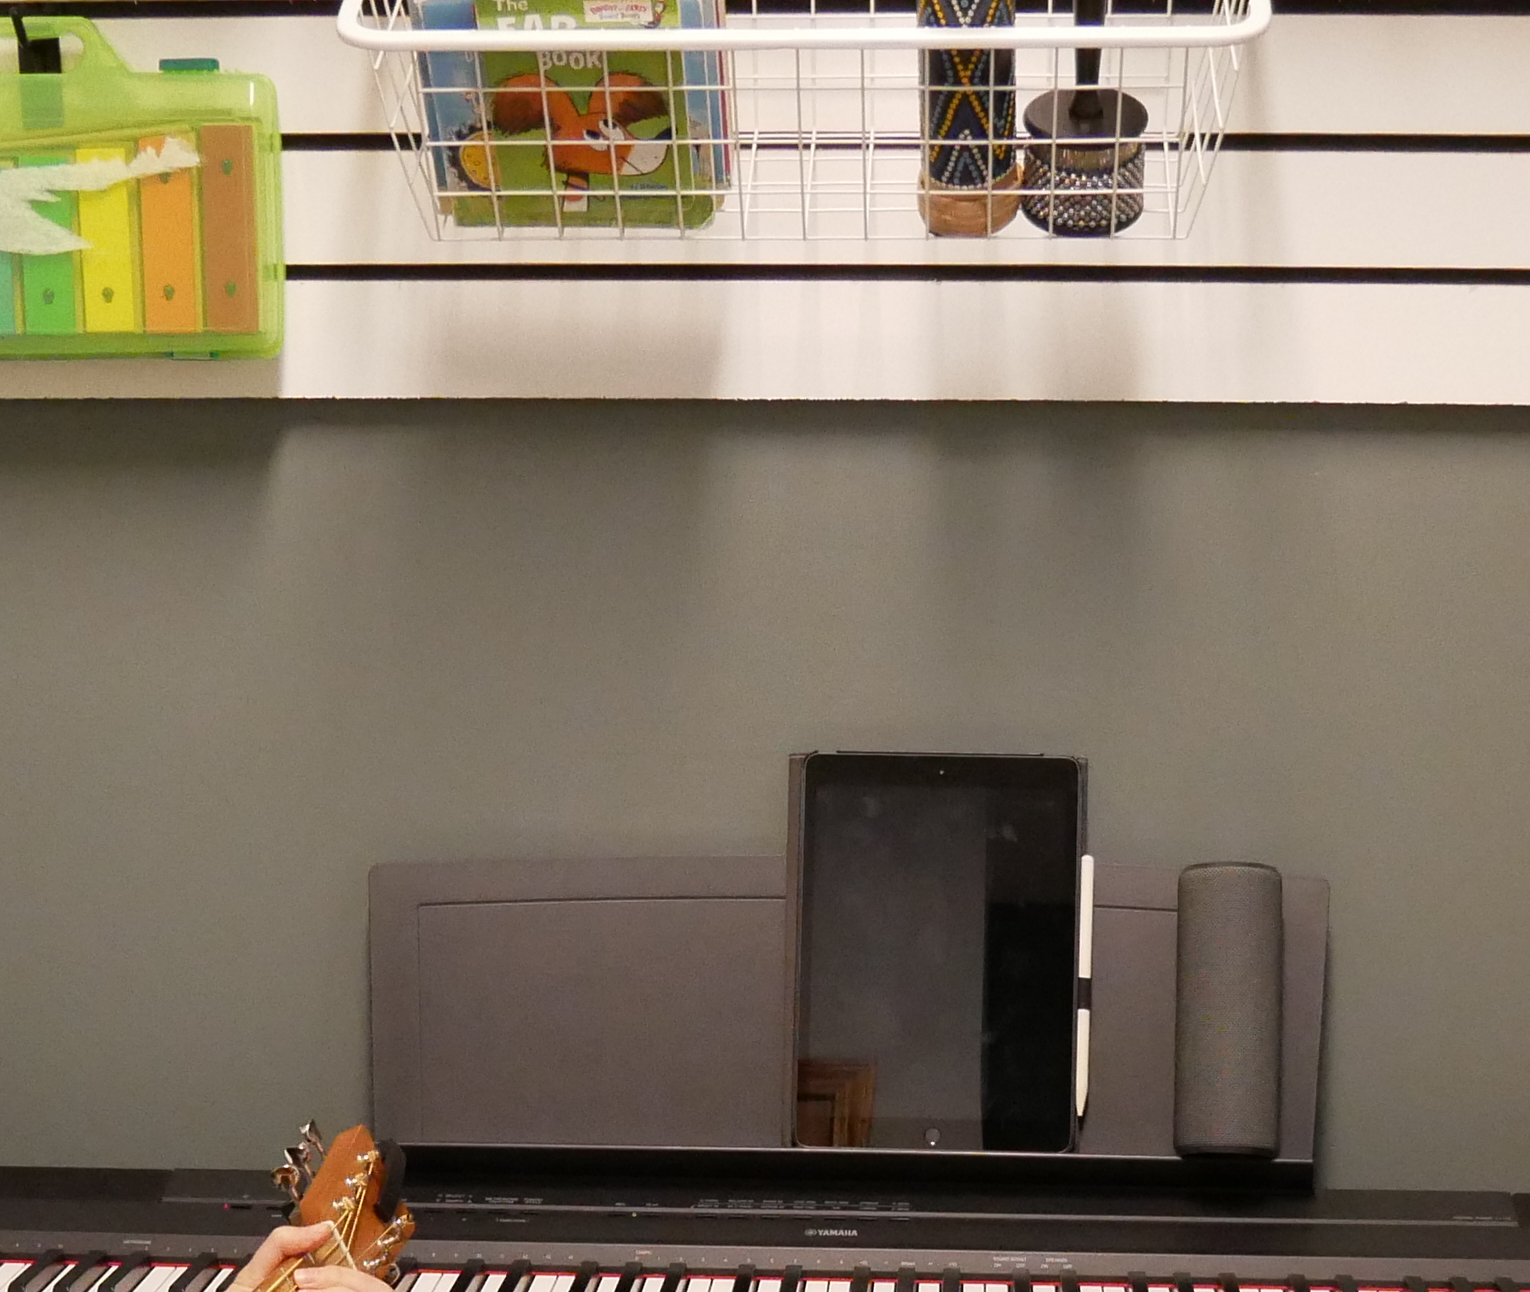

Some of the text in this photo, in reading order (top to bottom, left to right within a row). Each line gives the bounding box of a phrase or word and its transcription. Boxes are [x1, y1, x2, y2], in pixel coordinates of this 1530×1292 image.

[494, 0, 529, 12] The
[538, 50, 602, 70] BOOK
[817, 1229, 858, 1237] YAMAHA
